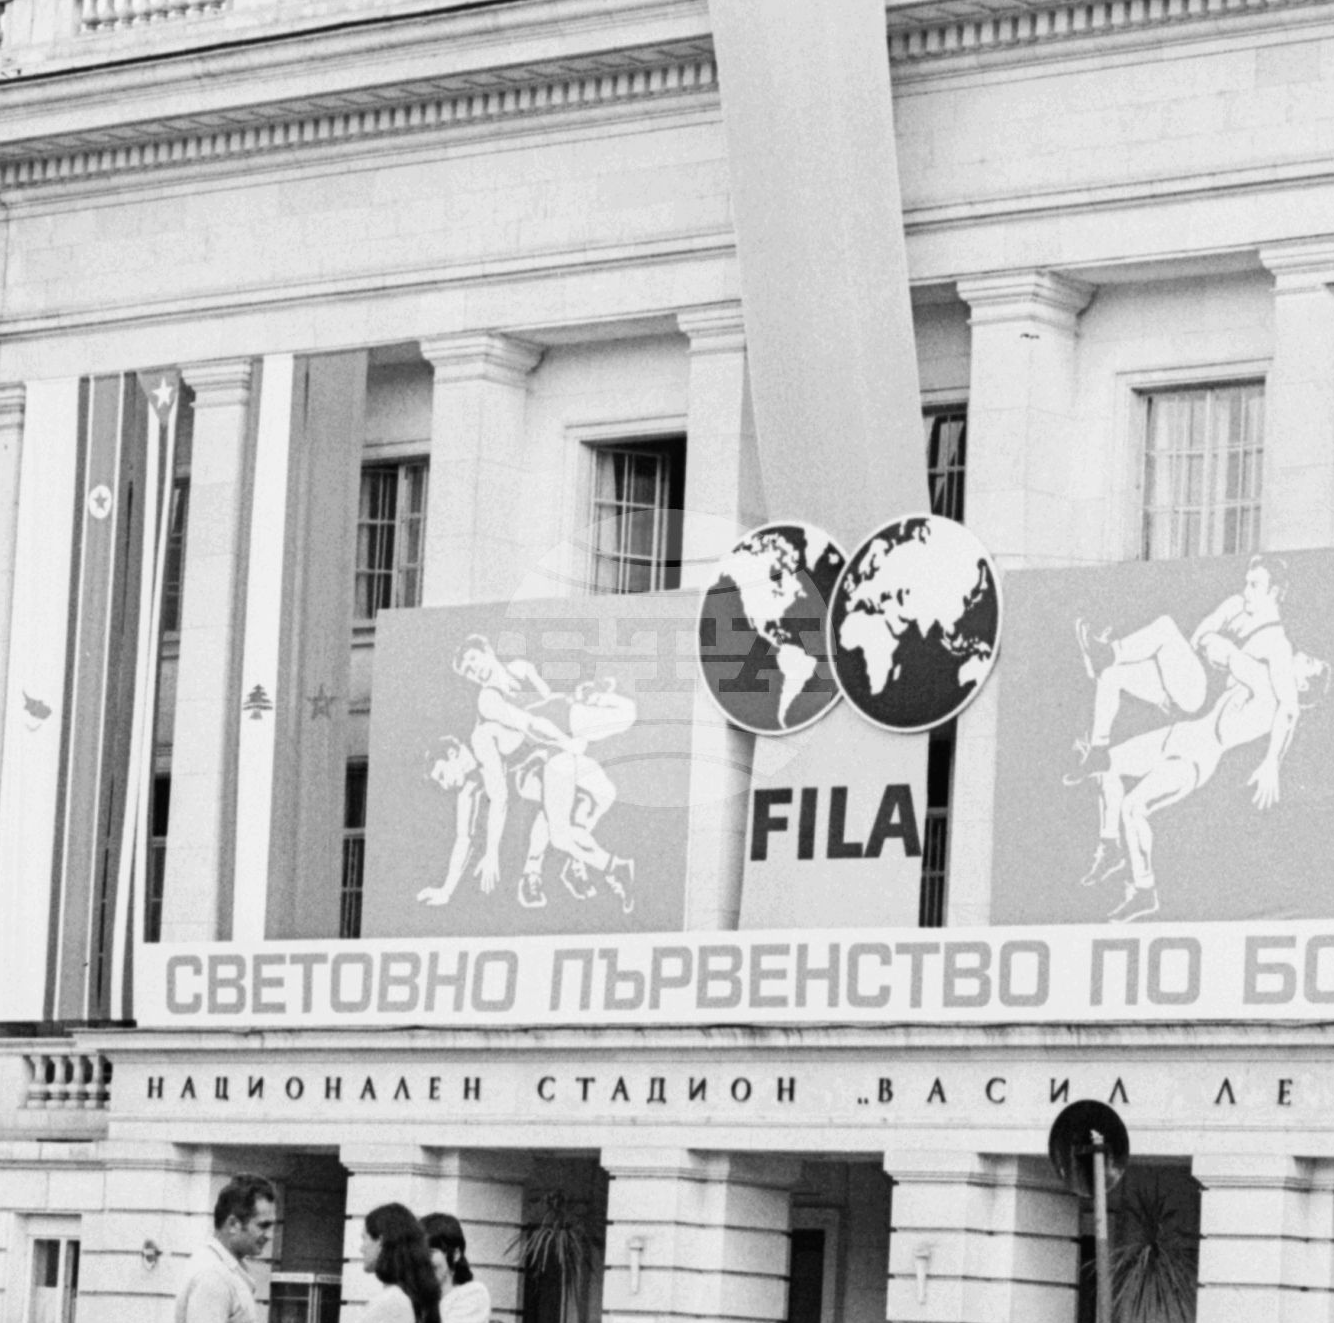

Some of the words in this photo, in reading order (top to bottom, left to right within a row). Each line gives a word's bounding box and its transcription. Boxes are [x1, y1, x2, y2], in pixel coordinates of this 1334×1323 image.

[750, 783, 923, 862] FILA
[166, 949, 520, 1015] СВЕТОВНО
[549, 939, 1052, 1012] ПЪРВЕНСТВО
[1089, 936, 1203, 1006] ПО
[147, 1075, 483, 1103] НАЦИОНАЛЕН
[536, 1075, 797, 1105] СТАДИОН
